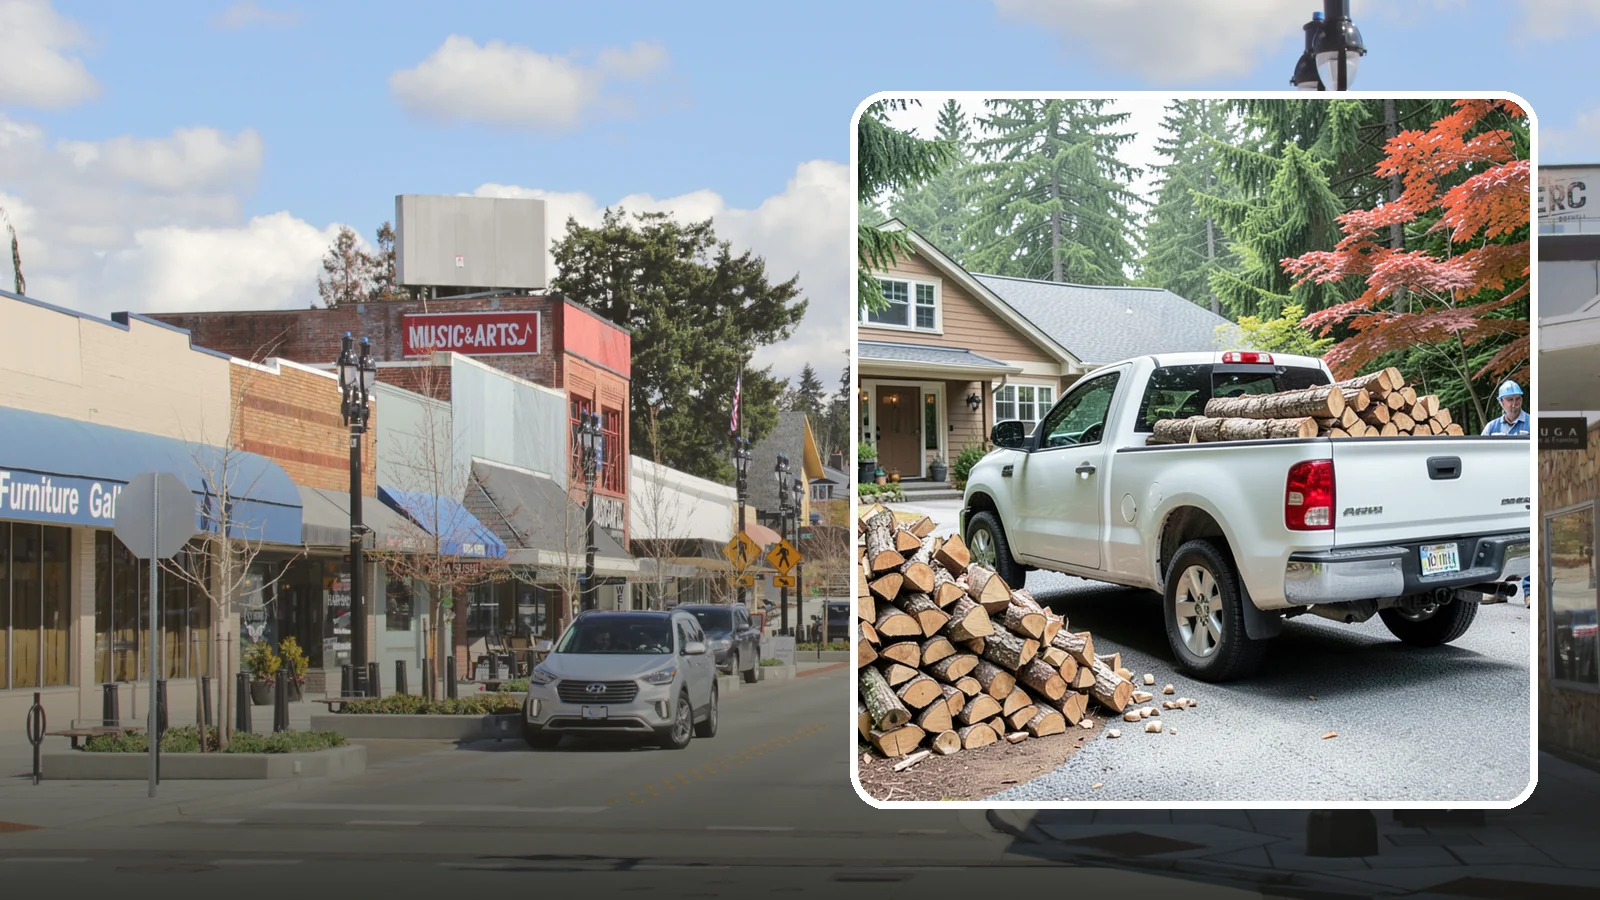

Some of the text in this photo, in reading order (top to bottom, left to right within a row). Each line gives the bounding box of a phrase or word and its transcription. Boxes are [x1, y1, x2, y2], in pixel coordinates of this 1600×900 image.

[0, 471, 122, 519] Furniture Gal
[453, 563, 480, 574] SUSHI
